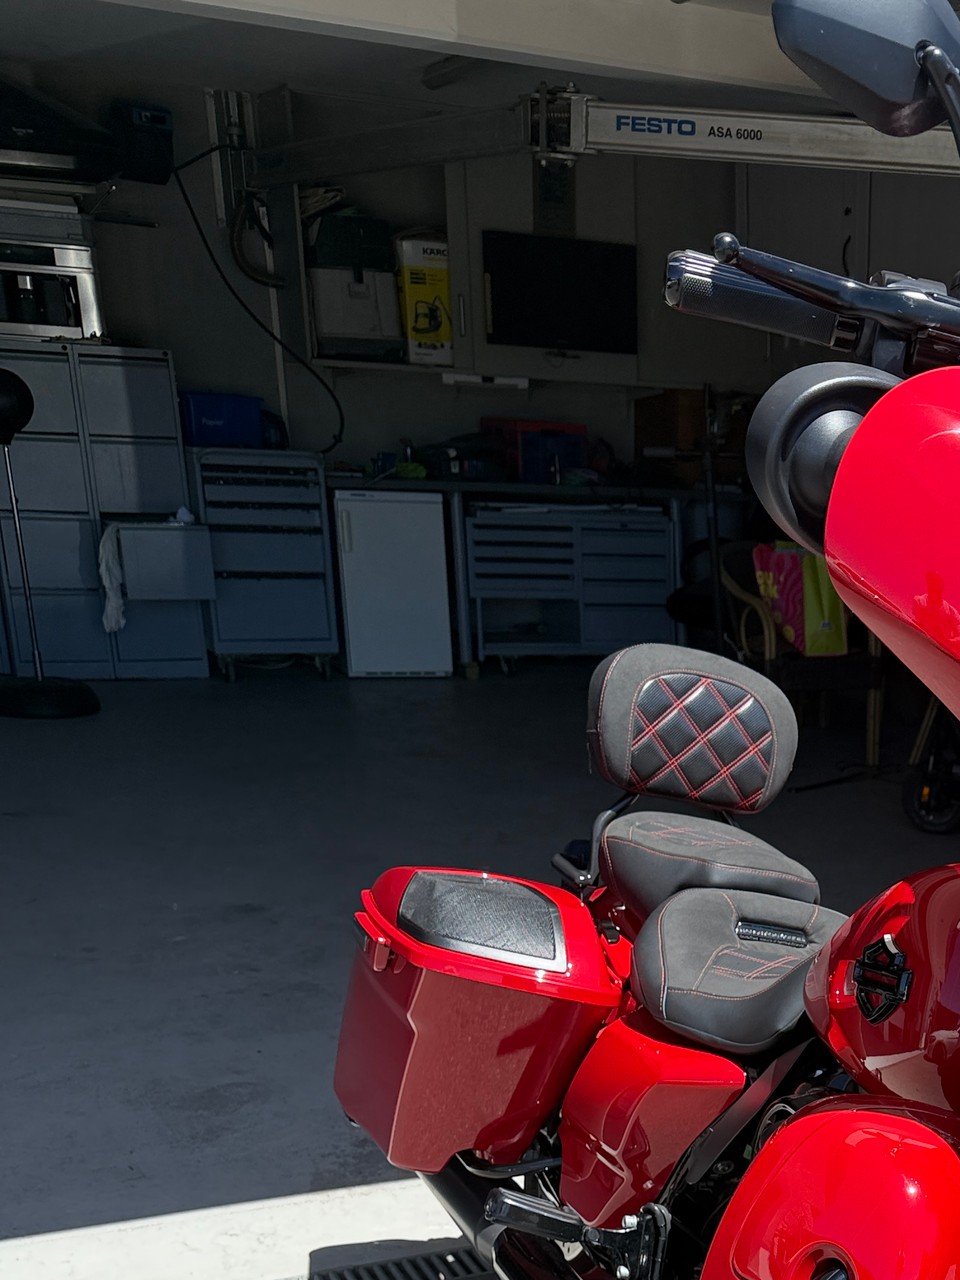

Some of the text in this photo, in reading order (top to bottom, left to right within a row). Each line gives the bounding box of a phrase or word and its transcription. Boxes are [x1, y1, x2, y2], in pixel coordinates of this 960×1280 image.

[616, 115, 763, 141] FESTO ASA 6000
